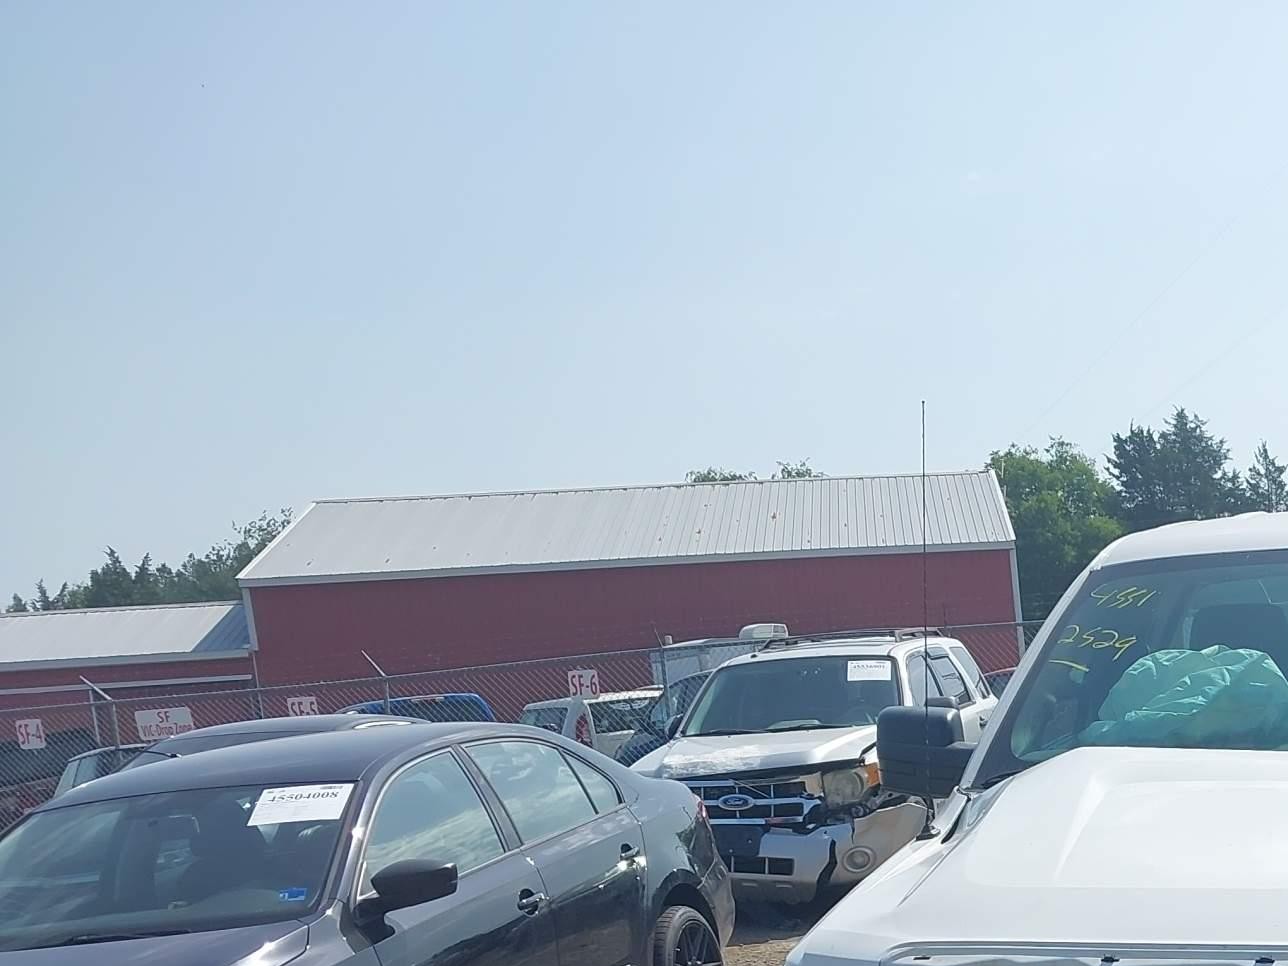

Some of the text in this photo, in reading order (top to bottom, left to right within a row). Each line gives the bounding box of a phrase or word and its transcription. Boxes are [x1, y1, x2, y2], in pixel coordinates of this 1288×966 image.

[1057, 624, 1137, 661] 2529
[570, 674, 598, 696] SF-6
[156, 711, 170, 723] SF
[18, 723, 44, 745] SF-4
[267, 791, 339, 802] 45504008
